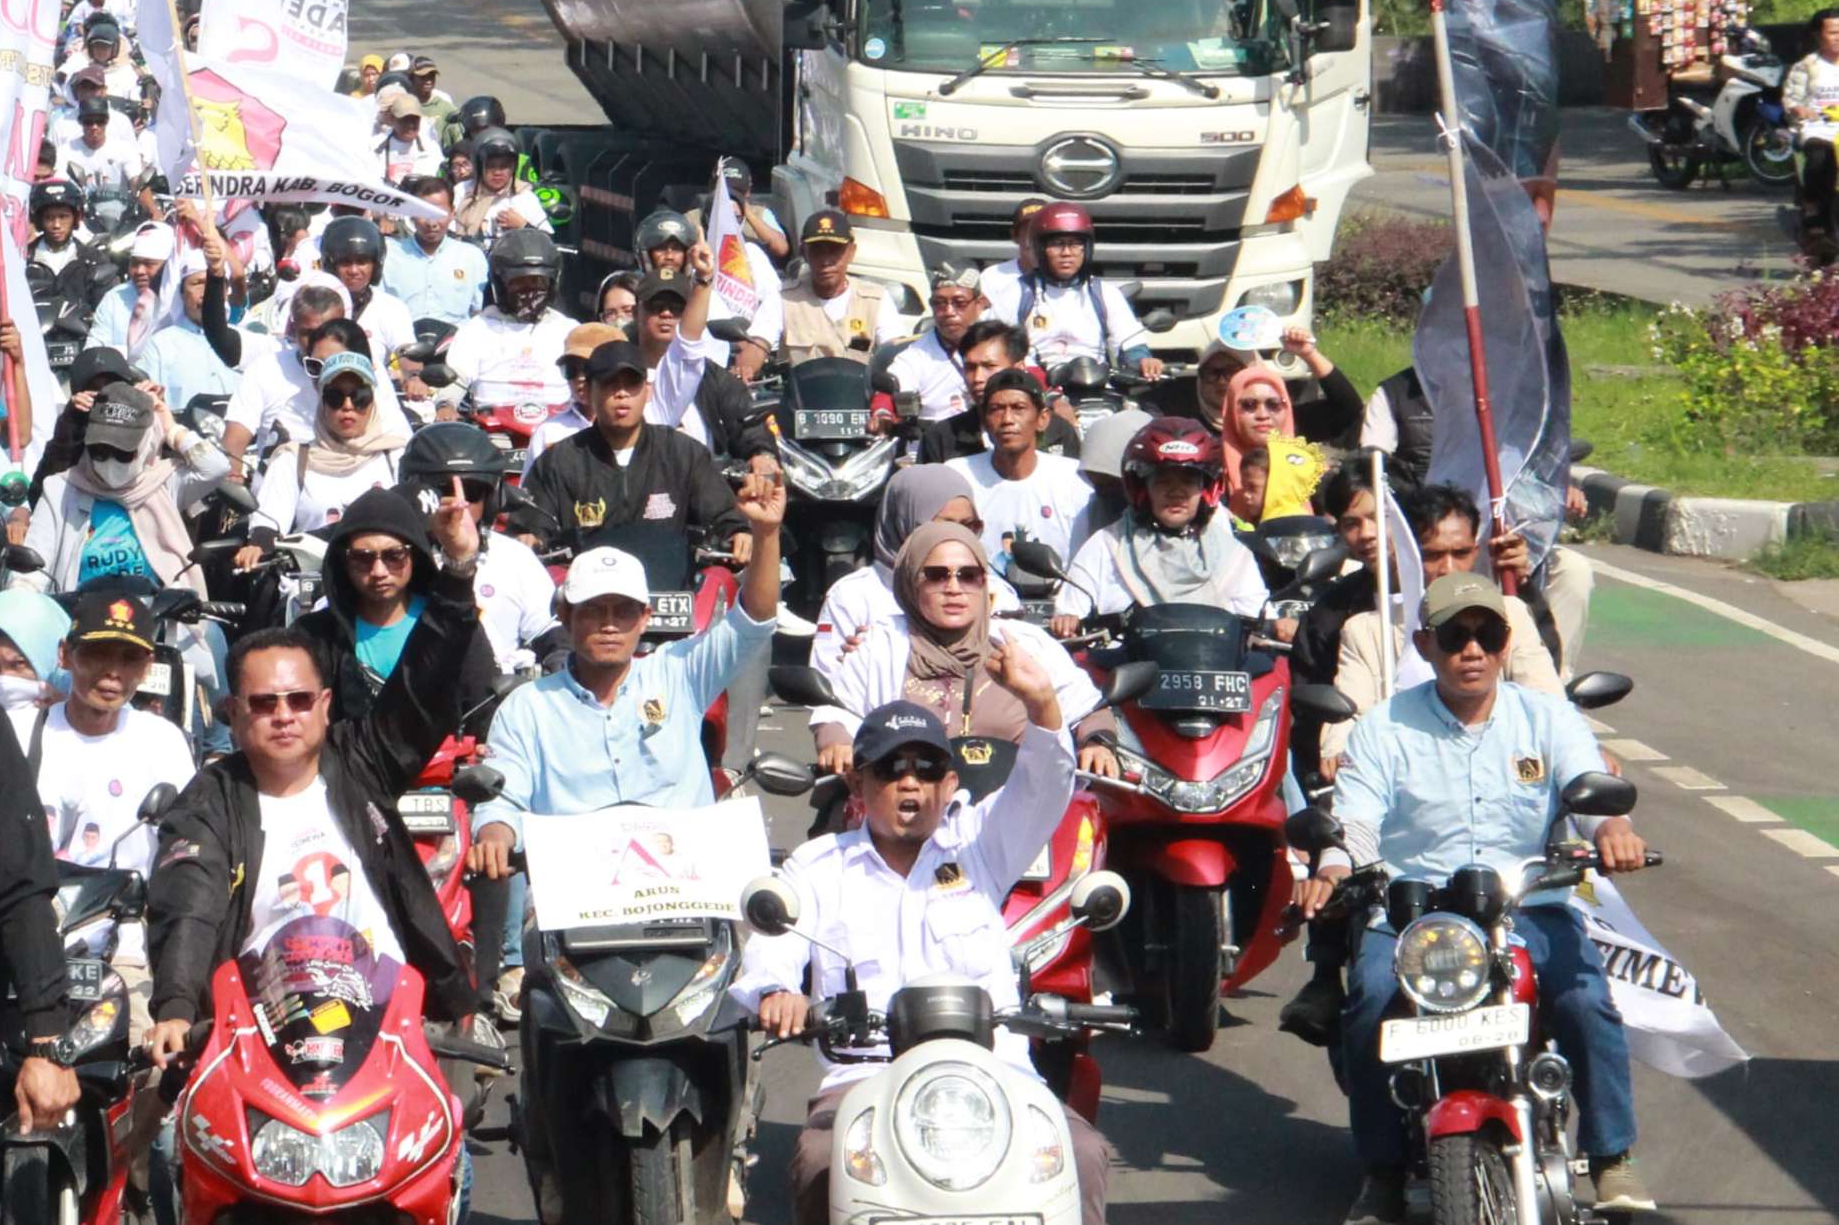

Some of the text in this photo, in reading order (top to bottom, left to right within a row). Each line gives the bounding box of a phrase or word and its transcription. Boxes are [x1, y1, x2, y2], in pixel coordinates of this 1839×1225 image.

[900, 122, 1256, 143] HINO 500
[272, 176, 318, 194] KAB.
[325, 181, 406, 208] BOGOR
[87, 547, 141, 570] RUDY
[657, 598, 689, 613] ETX
[1161, 674, 1246, 692] 2958 FHC
[633, 886, 681, 900] ARUS
[622, 900, 737, 917] BOJONGGEDE
[1480, 1008, 1521, 1026] KES
